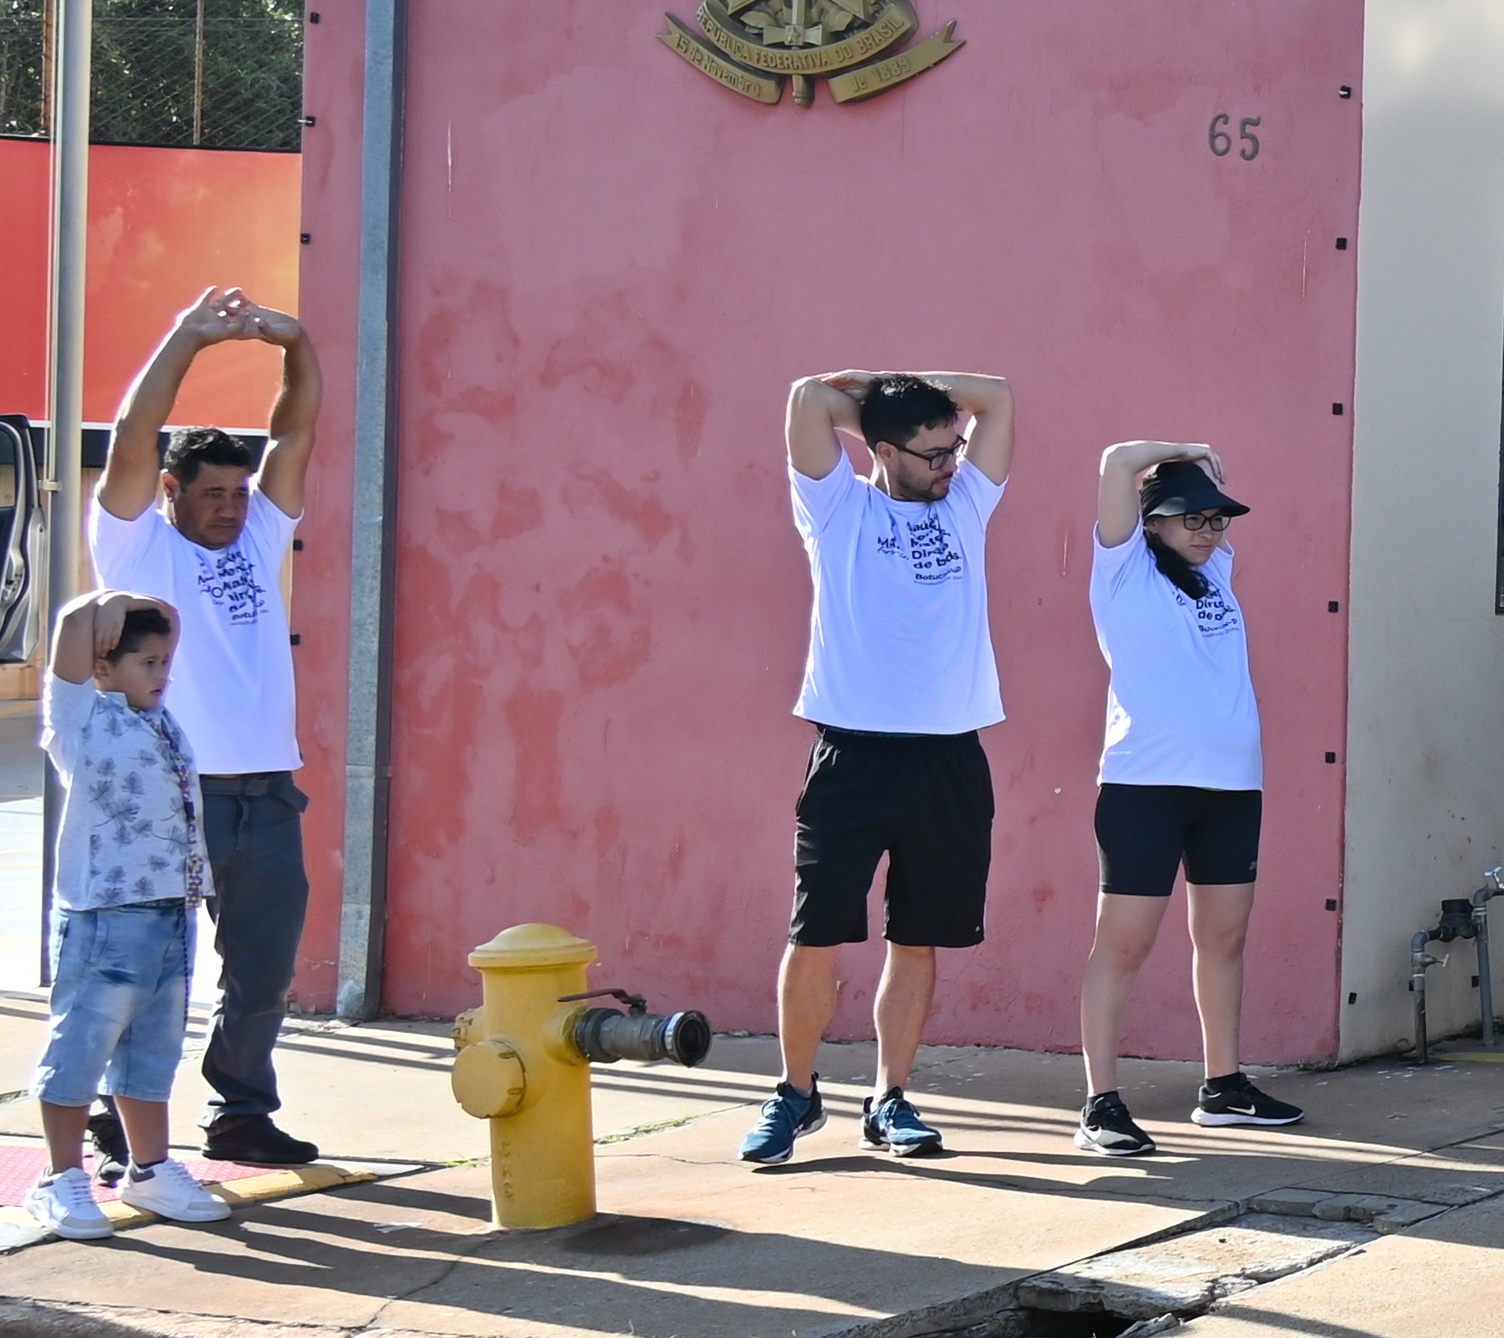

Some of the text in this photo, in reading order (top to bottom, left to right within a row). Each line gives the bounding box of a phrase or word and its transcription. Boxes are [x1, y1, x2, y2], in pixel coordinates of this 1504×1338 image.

[676, 35, 688, 54] 15
[858, 16, 905, 53] BRASIL
[1208, 112, 1261, 161] 65
